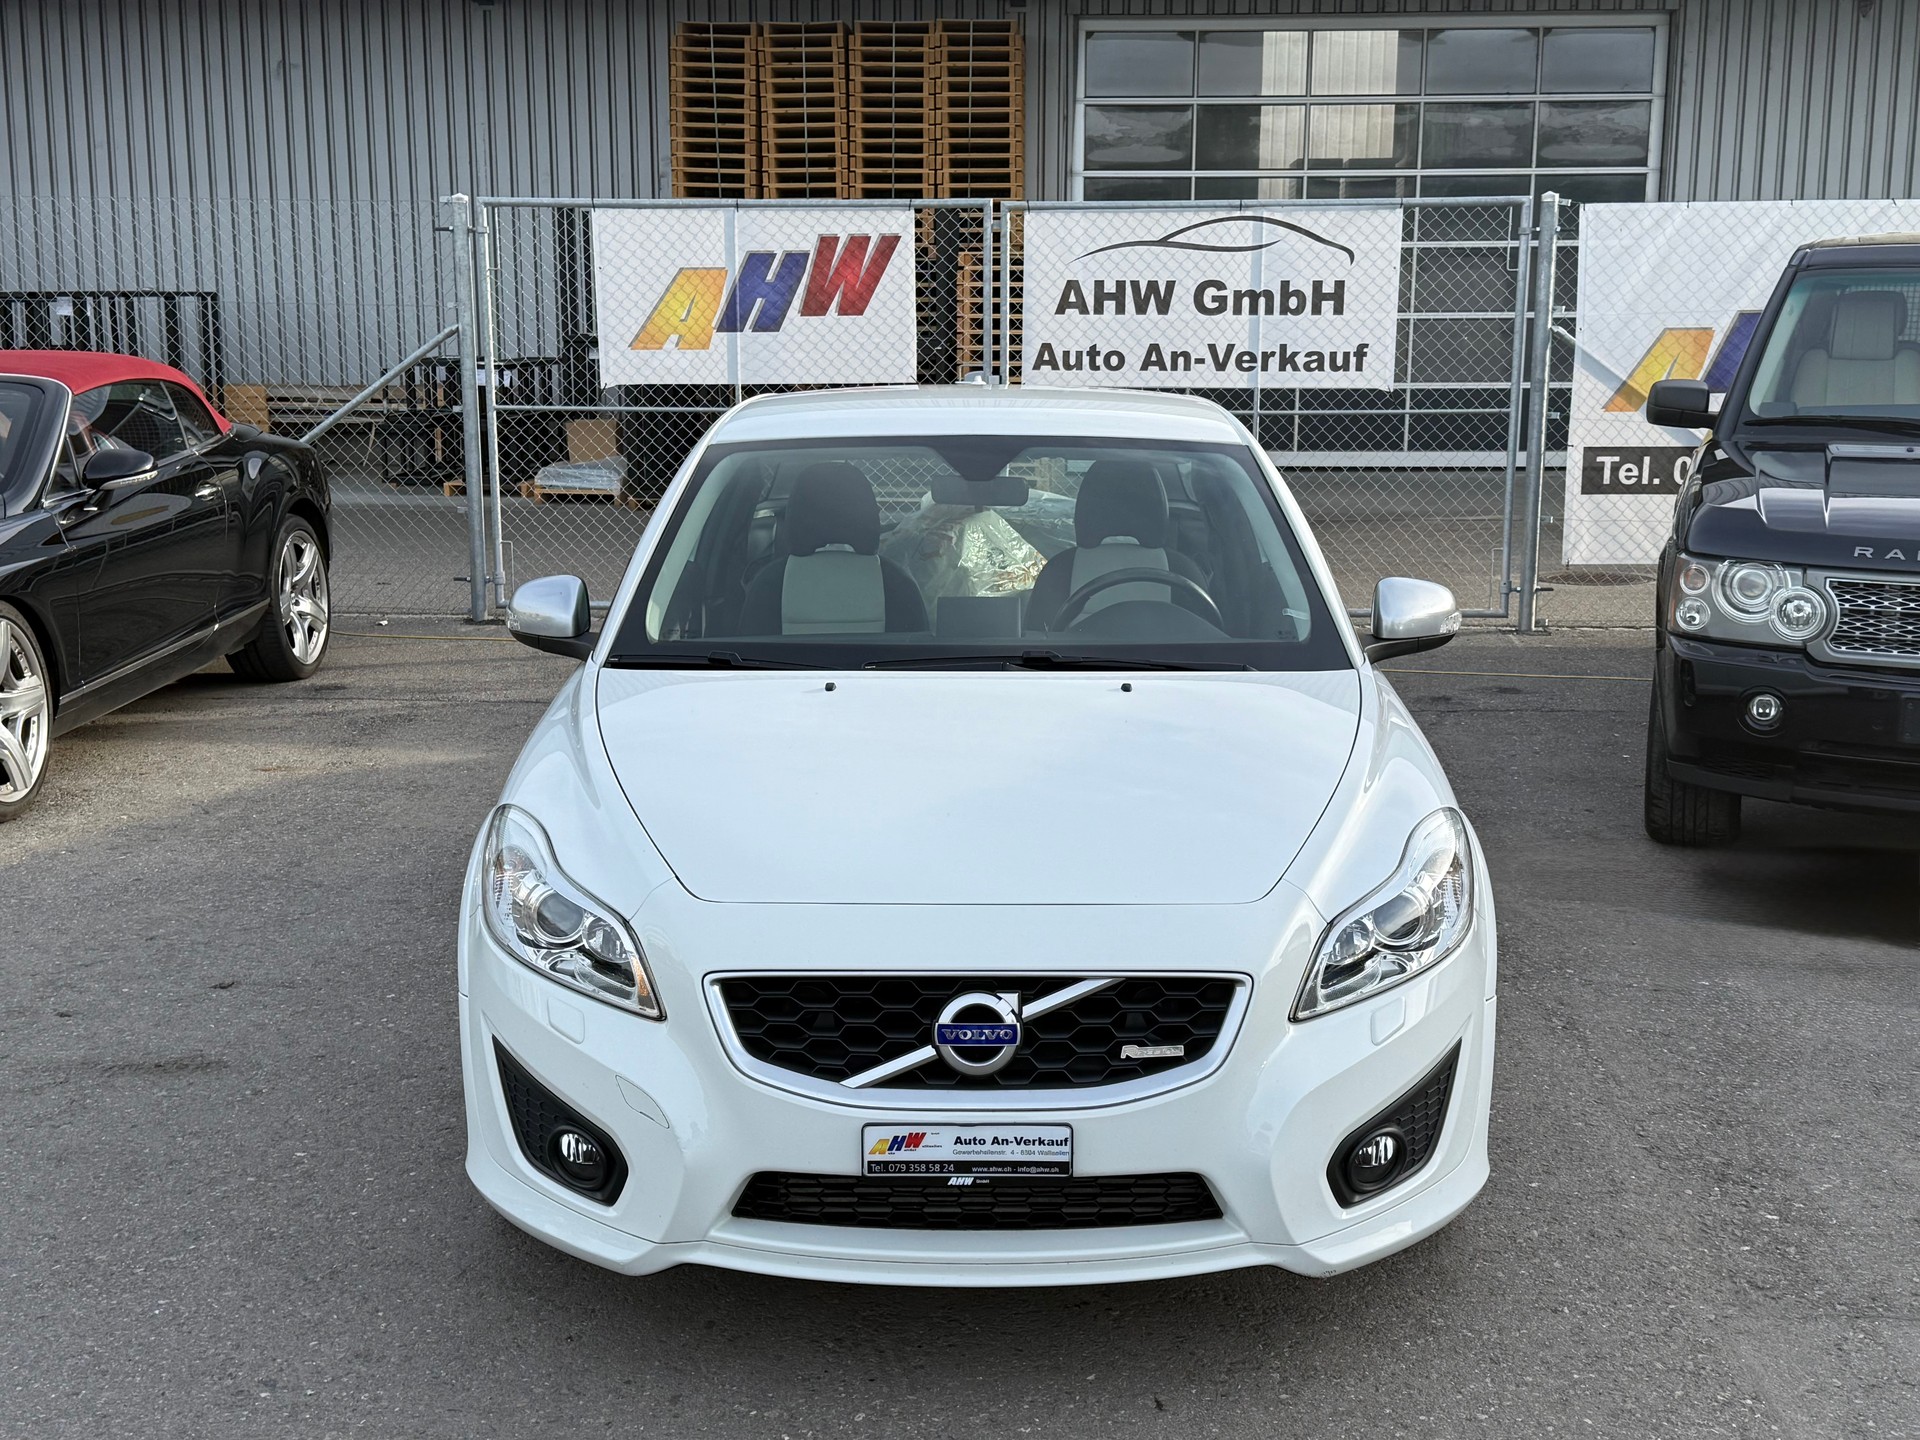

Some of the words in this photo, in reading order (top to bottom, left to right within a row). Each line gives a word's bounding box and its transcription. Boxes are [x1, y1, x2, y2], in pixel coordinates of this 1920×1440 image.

[628, 232, 902, 351] AHW
[1054, 279, 1177, 316] AHW
[1193, 278, 1346, 317] GmbH
[1031, 342, 1126, 372] Auto
[1139, 342, 1370, 373] An-Verkauf
[1596, 455, 1660, 486] Tel.
[1853, 546, 1920, 561] RA
[941, 1028, 1014, 1040] VOLVO
[868, 1132, 927, 1155] AHW
[953, 1136, 986, 1146] Auto
[990, 1136, 1069, 1147] An-Verkauf
[870, 1163, 886, 1172] Tel.
[888, 1163, 906, 1172] 079
[908, 1163, 926, 1172] 358
[928, 1163, 940, 1172] 58
[942, 1163, 955, 1172] 24
[971, 1165, 1013, 1173] www.ahw.ch
[1017, 1165, 1060, 1174] info@ahw.ch
[947, 1177, 974, 1186] AHW
